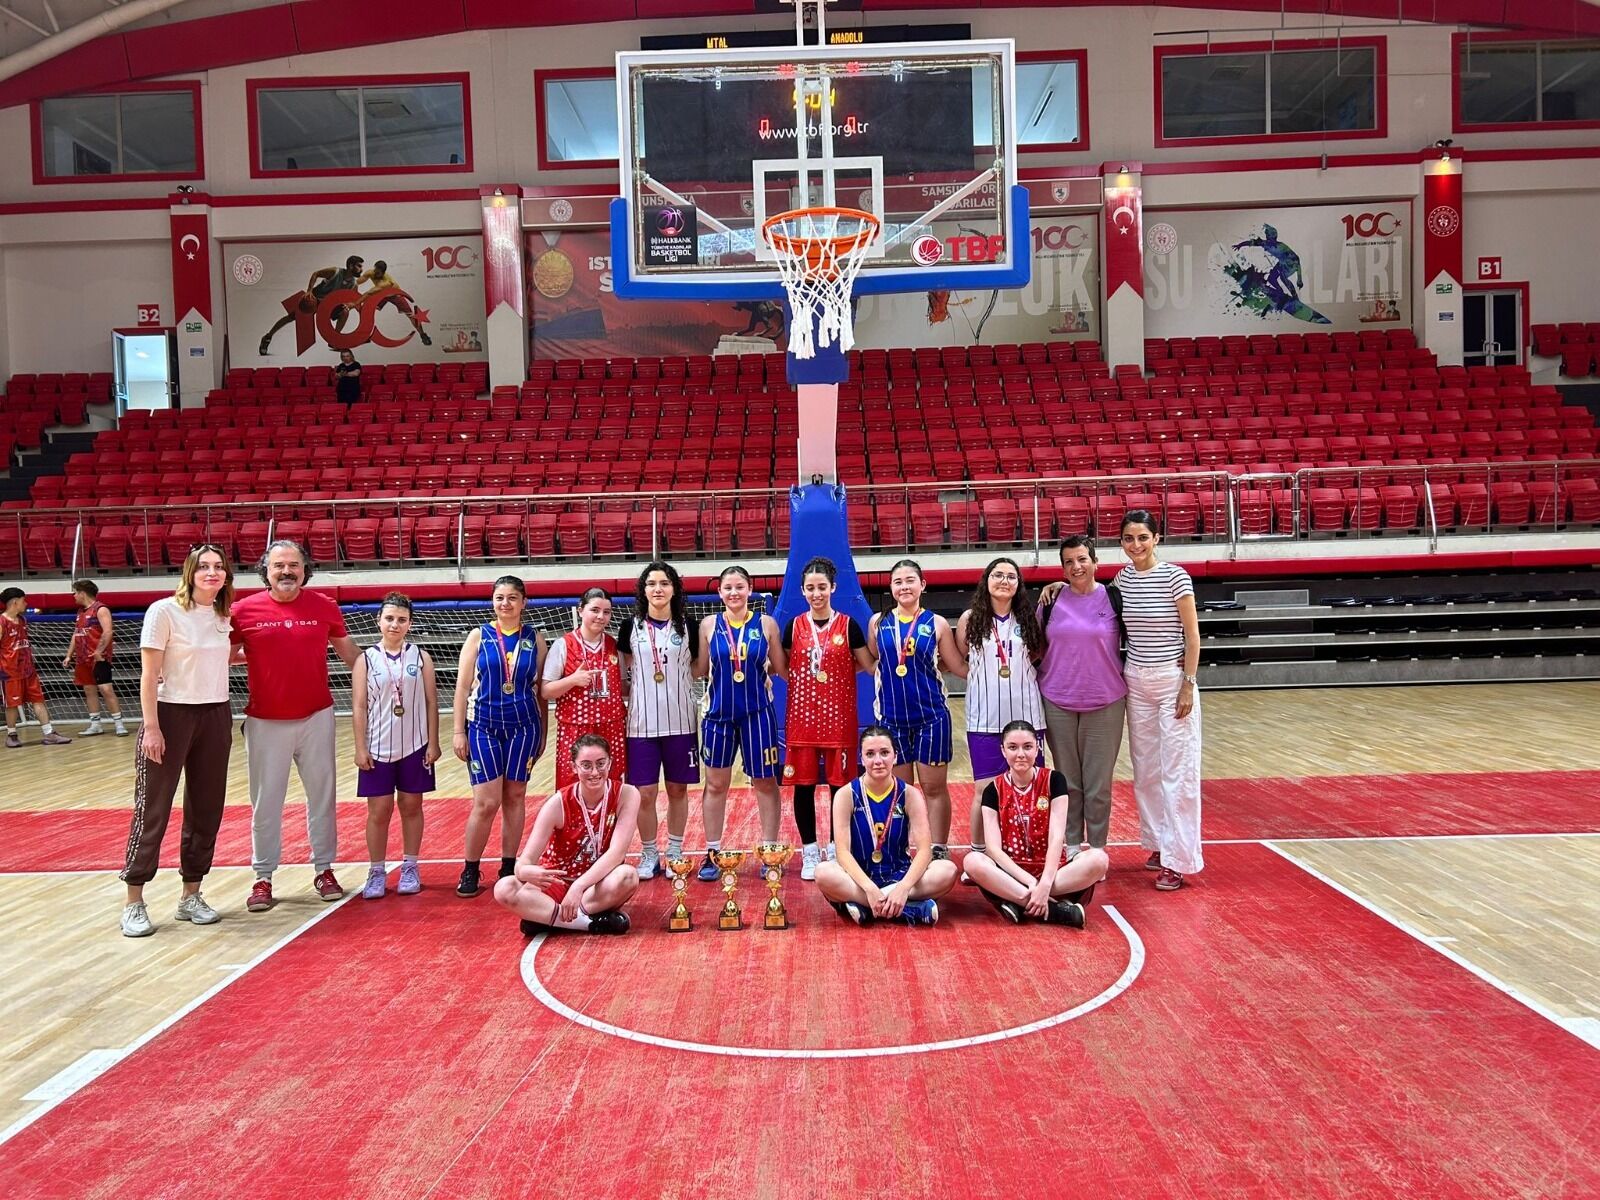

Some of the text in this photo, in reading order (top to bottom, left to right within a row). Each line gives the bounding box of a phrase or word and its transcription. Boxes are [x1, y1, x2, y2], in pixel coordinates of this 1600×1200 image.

[831, 31, 863, 44] ANADOLU
[650, 249, 692, 257] BASKETBOL
[945, 235, 1005, 264] TBF
[1481, 261, 1501, 275] B1
[138, 308, 160, 322] B2
[764, 747, 778, 766] 10
